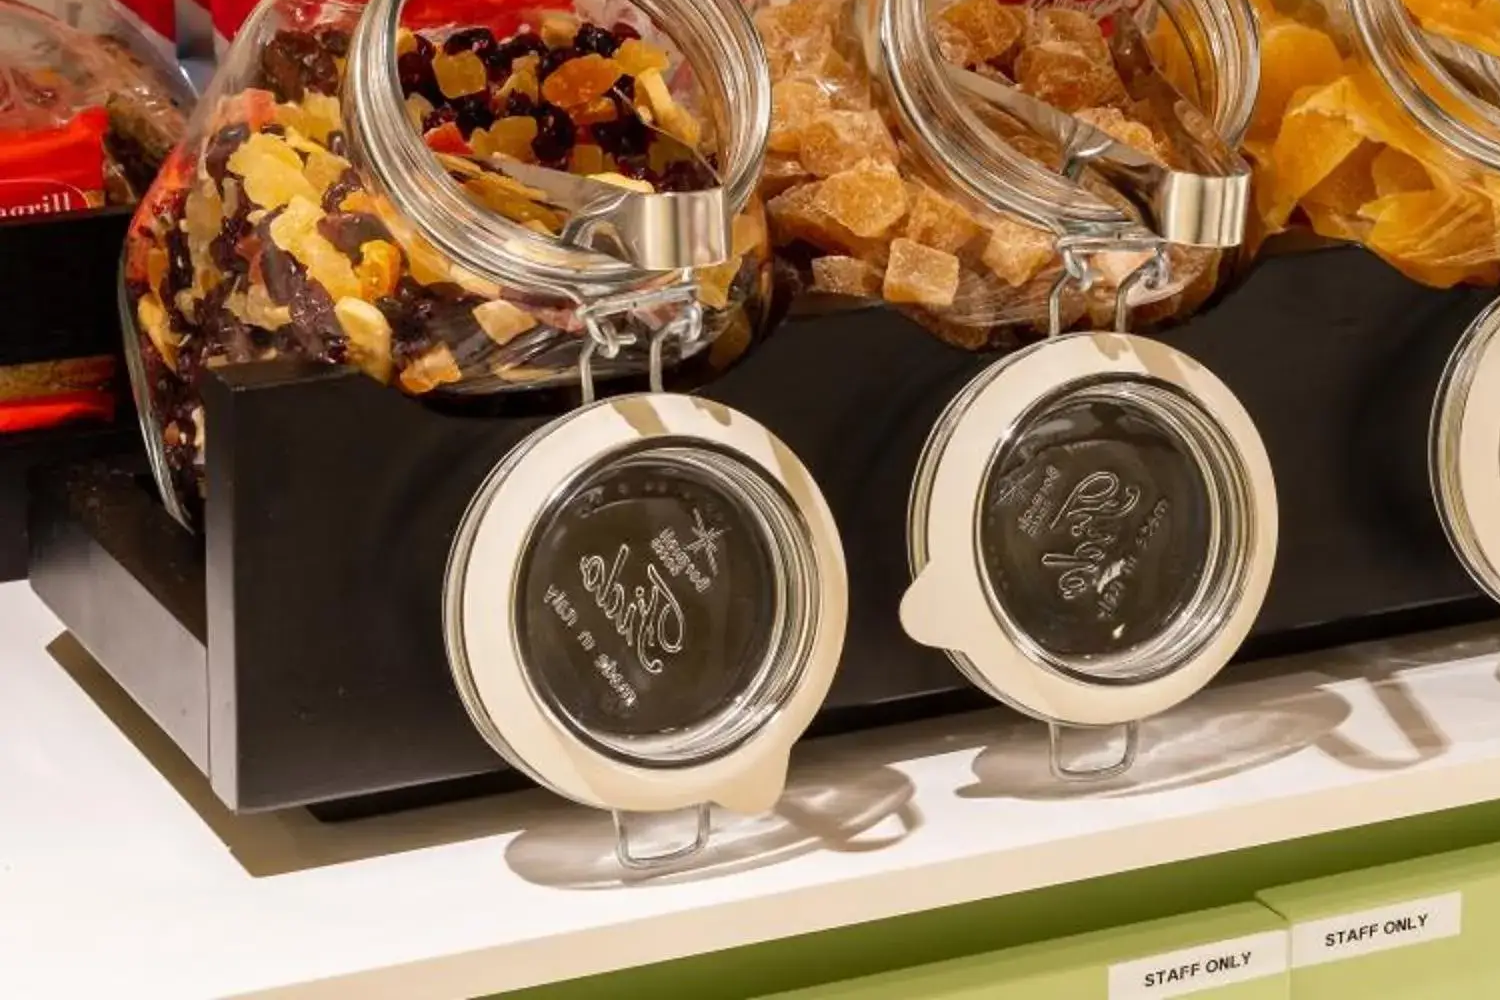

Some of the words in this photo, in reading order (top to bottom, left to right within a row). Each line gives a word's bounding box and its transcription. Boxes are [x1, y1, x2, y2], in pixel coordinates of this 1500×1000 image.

[1325, 923, 1380, 948] STAFF
[1383, 913, 1429, 936] ONLY
[1144, 963, 1201, 988] STAFF
[1205, 951, 1253, 975] ONLY
